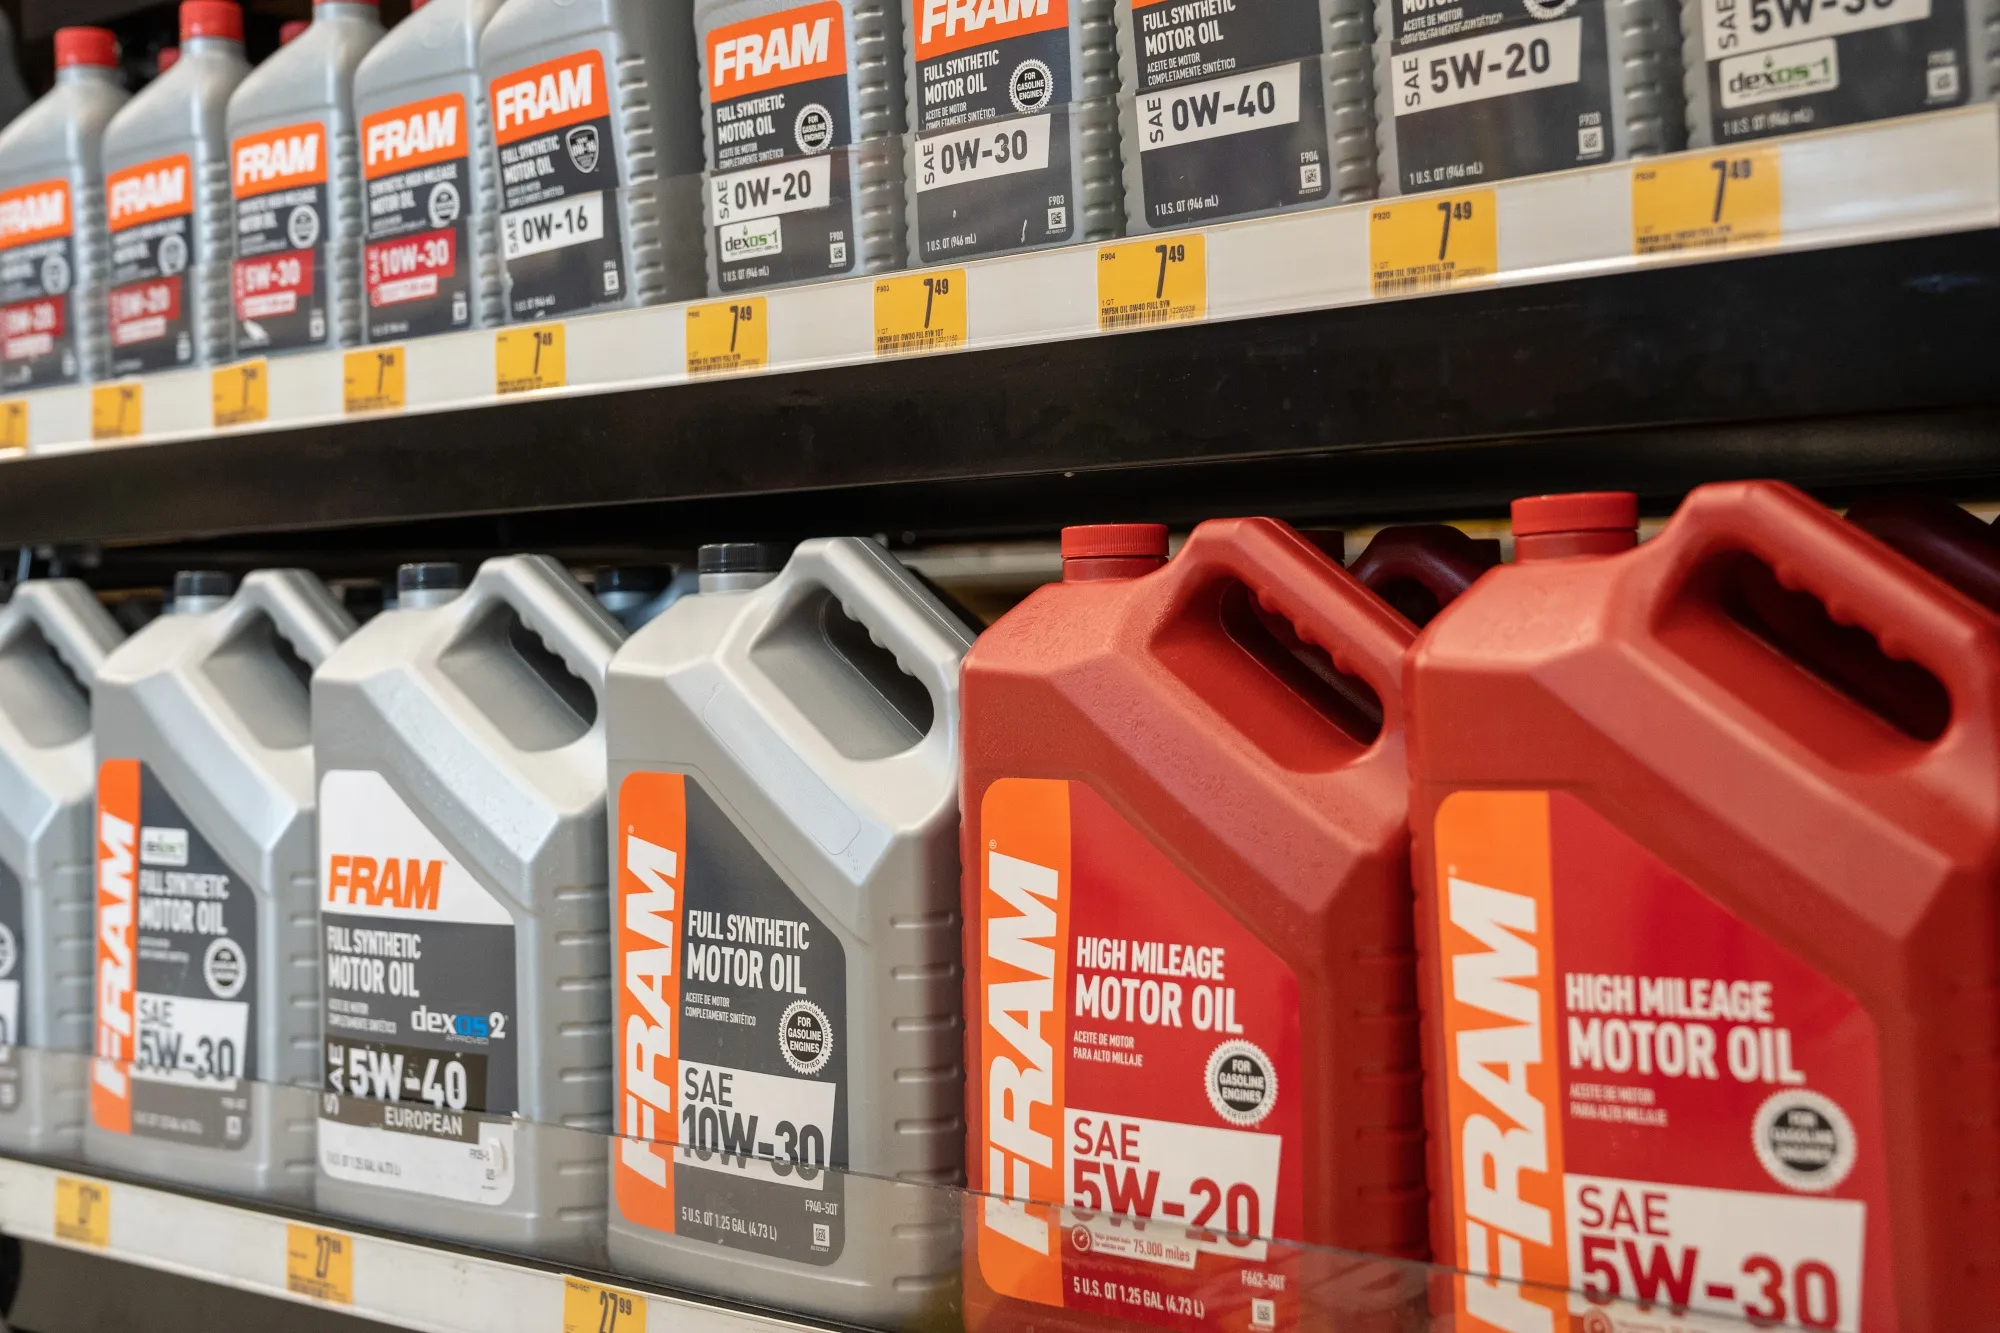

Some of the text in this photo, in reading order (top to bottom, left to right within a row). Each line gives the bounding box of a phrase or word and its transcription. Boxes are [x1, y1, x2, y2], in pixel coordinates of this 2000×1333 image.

[1142, 0, 1236, 32] FULL SYNTHETIC
[1403, 15, 1426, 32] ACEITE
[1427, 13, 1436, 26] DE
[1437, 7, 1463, 24] MOTOR
[713, 18, 831, 87] FRAM
[1144, 20, 1224, 57] MOTOR OIL
[924, 49, 1000, 83] FULL SYNTHETIC
[1024, 71, 1036, 81] FOR
[1147, 52, 1200, 73] ACEITE DE MOTOR
[1148, 57, 1236, 86] COMPLETAMENTE SINTÉTICO
[1429, 38, 1550, 93] 5W-20
[496, 63, 592, 131] FRAM
[924, 72, 987, 106] MOTOR OIL
[1016, 79, 1044, 92] GASOLINE
[1019, 89, 1043, 101] ENGINES
[1403, 58, 1420, 107] SAE
[716, 94, 785, 123] FULL SYNTHETIC
[808, 115, 818, 124] FOR
[925, 102, 967, 121] ACEITE DE MOTOR
[967, 107, 996, 123] SINTÉTICO
[1147, 97, 1164, 144] SAE
[1171, 81, 1276, 132] 0W-40
[367, 106, 457, 166] FRAM
[718, 115, 776, 145] MOTOR OIL
[802, 124, 825, 134] GASOLINE
[803, 132, 826, 142] ENGINES
[236, 133, 321, 187] FRAM
[518, 134, 560, 160] SYNTHETIC
[923, 143, 935, 185] SAE
[940, 129, 1028, 175] 0W-30
[1300, 151, 1319, 163] F904
[502, 154, 555, 185] MOTOR OIL
[1416, 171, 1431, 184] U.S.
[1433, 168, 1445, 181] QT
[1446, 164, 1464, 179] (946
[1466, 161, 1484, 176] mL)
[110, 165, 185, 220] FRAM
[719, 180, 729, 219] SAE
[735, 170, 812, 210] 0W-20
[1048, 195, 1064, 206] F903
[1155, 194, 1219, 216] 1 U.S. QT (946 mL)
[507, 216, 518, 255] SAE
[521, 205, 589, 244] 0W-16
[829, 230, 844, 241] F900
[931, 239, 942, 251] U.S.
[943, 237, 950, 249] QT
[951, 235, 963, 248] (946
[963, 233, 976, 245] mL)
[380, 238, 449, 277] 10W-30
[1100, 253, 1116, 261] F904
[328, 854, 443, 911] FRAM
[138, 897, 228, 936] MOTOR OIL
[688, 909, 809, 950] FULL SYNTHETIC
[94, 809, 136, 1100] FRAM
[327, 925, 422, 960] FULL SYNTHETIC
[1076, 936, 1225, 981] HIGH MILEAGE
[328, 953, 420, 998] MOTOR OIL
[687, 943, 807, 995] MOTOR OIL
[138, 999, 174, 1029] SAE
[622, 834, 678, 1189] FRAM
[685, 992, 730, 1008] ACEITE DE MOTOR
[1075, 973, 1243, 1034] MOTOR OIL
[1565, 972, 1773, 1022] HIGH MILEAGE
[685, 1007, 756, 1027] COMPLETAMENTE SINTÉTICO
[788, 1028, 822, 1041] GASOLINE
[797, 1016, 811, 1027] FOR
[137, 1031, 236, 1081] 5W-30
[790, 1041, 820, 1053] ENGINES
[985, 850, 1059, 1257] FRAM
[1073, 1031, 1134, 1049] ACEITE DE MOTOR
[1073, 1047, 1143, 1068] PARA ALTO MILLAJE
[1568, 1016, 1806, 1085] MOTOR OIL
[323, 1042, 344, 1116] SAE
[348, 1047, 468, 1110] 5W-40
[789, 1055, 820, 1069] CERTIFIED
[1232, 1059, 1251, 1074] FOR
[684, 1067, 733, 1108] SAE
[1220, 1072, 1265, 1089] GASOLINE
[1222, 1086, 1262, 1103] ENGINES
[384, 1105, 463, 1136] EUROPEAN
[1447, 877, 1555, 1333] FRAM
[682, 1103, 824, 1181] 10W-30
[1073, 1117, 1141, 1162] SAE
[805, 1200, 838, 1216] F940-5QT
[1071, 1158, 1260, 1248] 5W-20
[1579, 1184, 1671, 1237] SAE
[682, 1207, 777, 1242] 5 U.S. QT 1.25 GAL (4.73 L)
[1165, 1245, 1190, 1262] miles
[1074, 1276, 1204, 1320] 5 U.S. QT 1.25 GAL (4.73 L)
[1580, 1235, 1841, 1333] 5W-30
